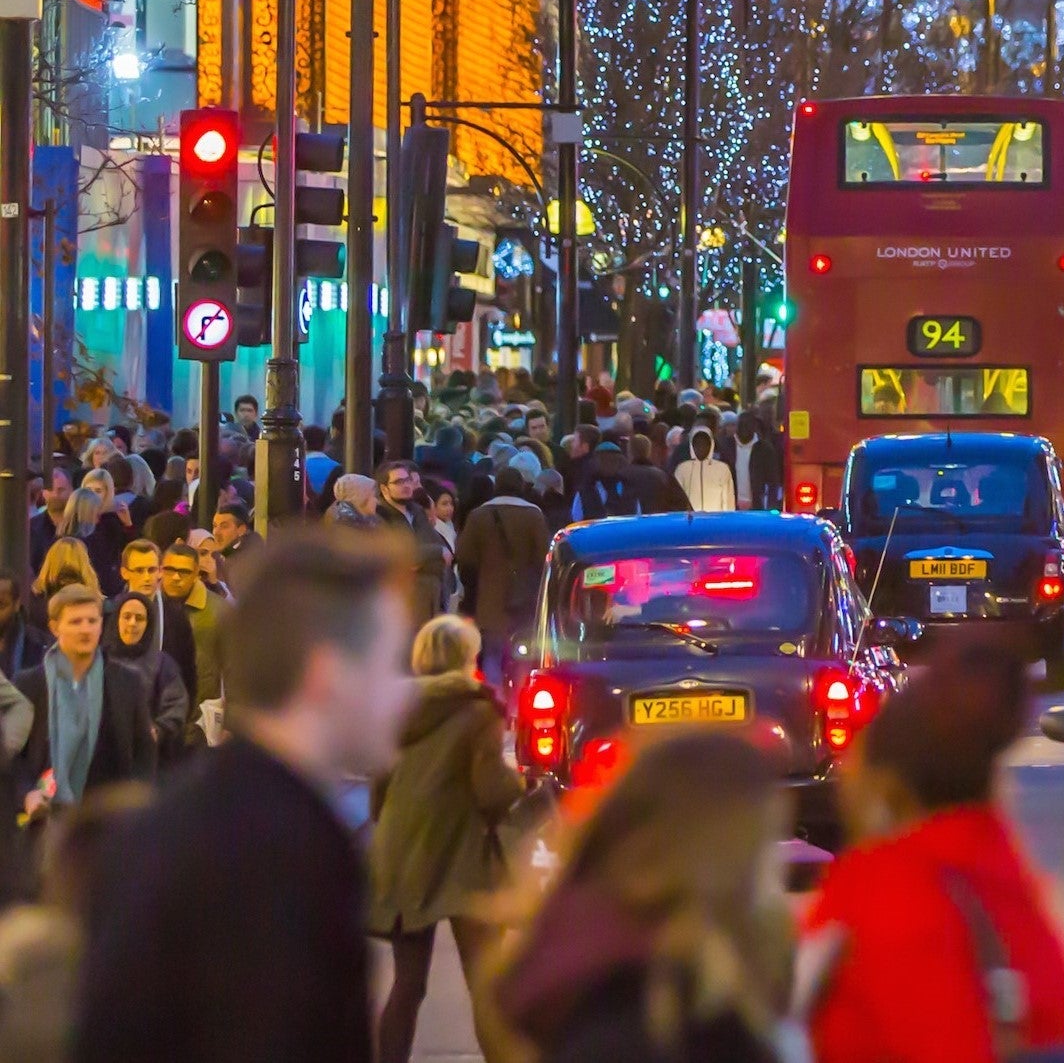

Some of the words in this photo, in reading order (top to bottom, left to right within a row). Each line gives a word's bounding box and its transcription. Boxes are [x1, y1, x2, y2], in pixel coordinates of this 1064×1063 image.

[876, 246, 941, 258] LONDON
[947, 246, 1012, 258] UNITED
[921, 319, 966, 350] 94
[293, 447, 301, 482] 145
[950, 562, 976, 575] BDF
[642, 700, 693, 719] Y256
[698, 698, 737, 717] HGJ
